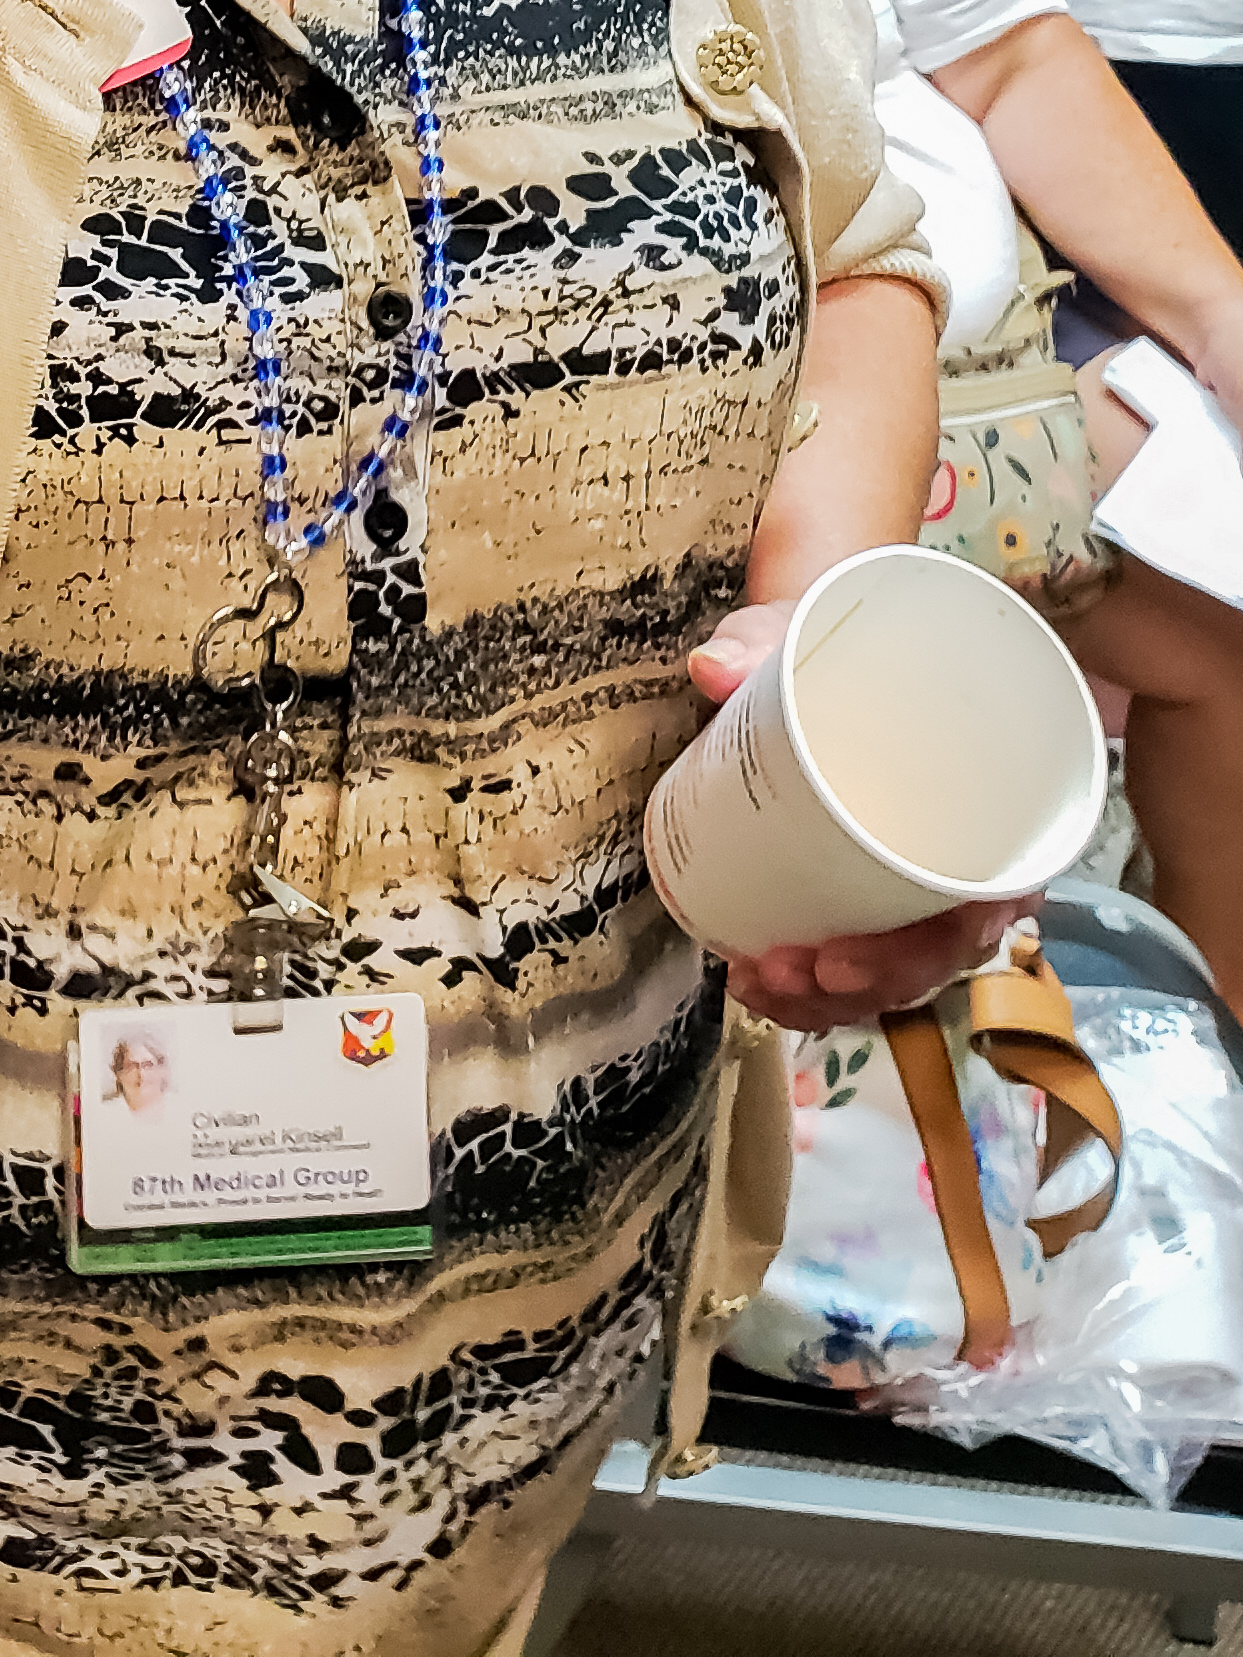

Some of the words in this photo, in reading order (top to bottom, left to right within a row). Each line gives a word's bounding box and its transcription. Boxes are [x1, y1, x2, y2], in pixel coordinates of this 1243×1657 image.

[131, 1174, 184, 1195] 87th
[192, 1168, 285, 1193] Medical
[293, 1166, 370, 1188] Group
